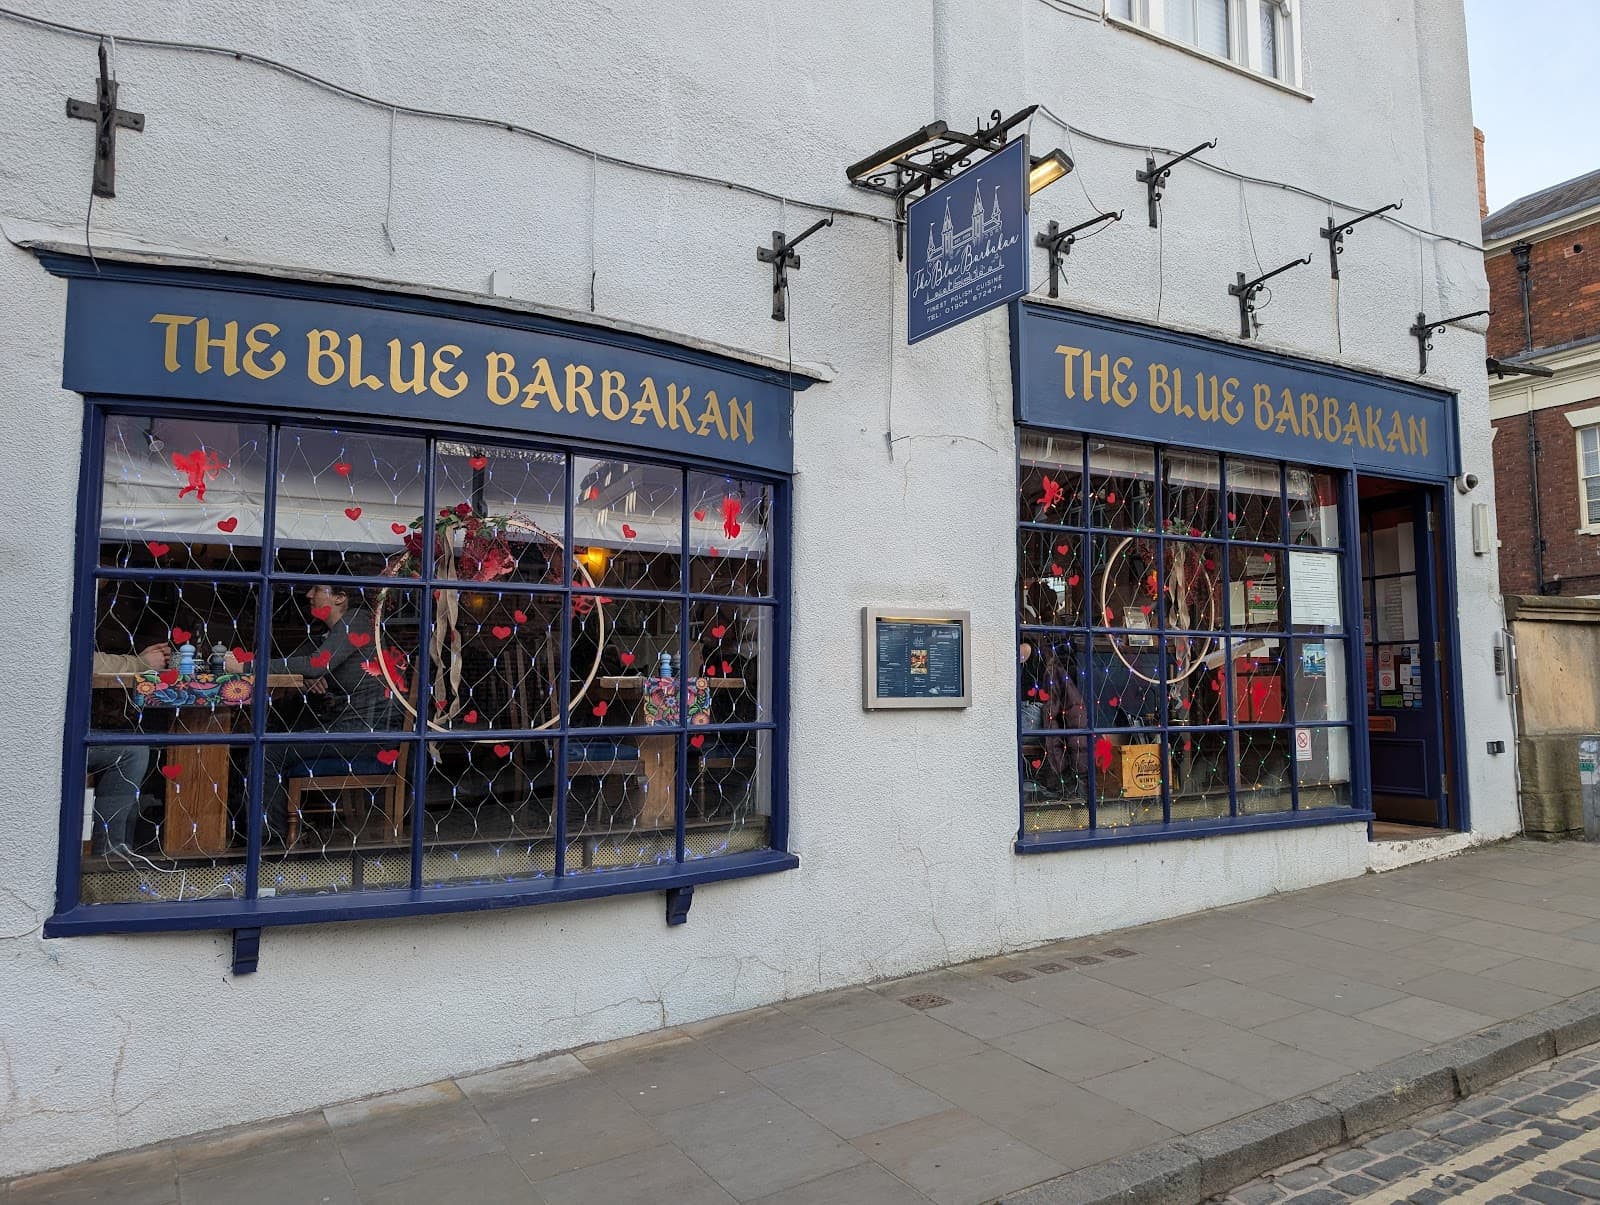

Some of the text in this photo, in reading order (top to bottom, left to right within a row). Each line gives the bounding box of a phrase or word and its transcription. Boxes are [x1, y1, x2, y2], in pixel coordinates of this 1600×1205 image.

[913, 233, 1019, 299] The Blue Barbakan
[926, 275, 1003, 314] FINEST POLISH CUISINE
[945, 299, 968, 314] 01904
[972, 283, 1002, 302] 672474
[150, 313, 756, 444] THE BLUE BARBAKAN
[1054, 344, 1429, 457] THE BLUE BARBAKAN
